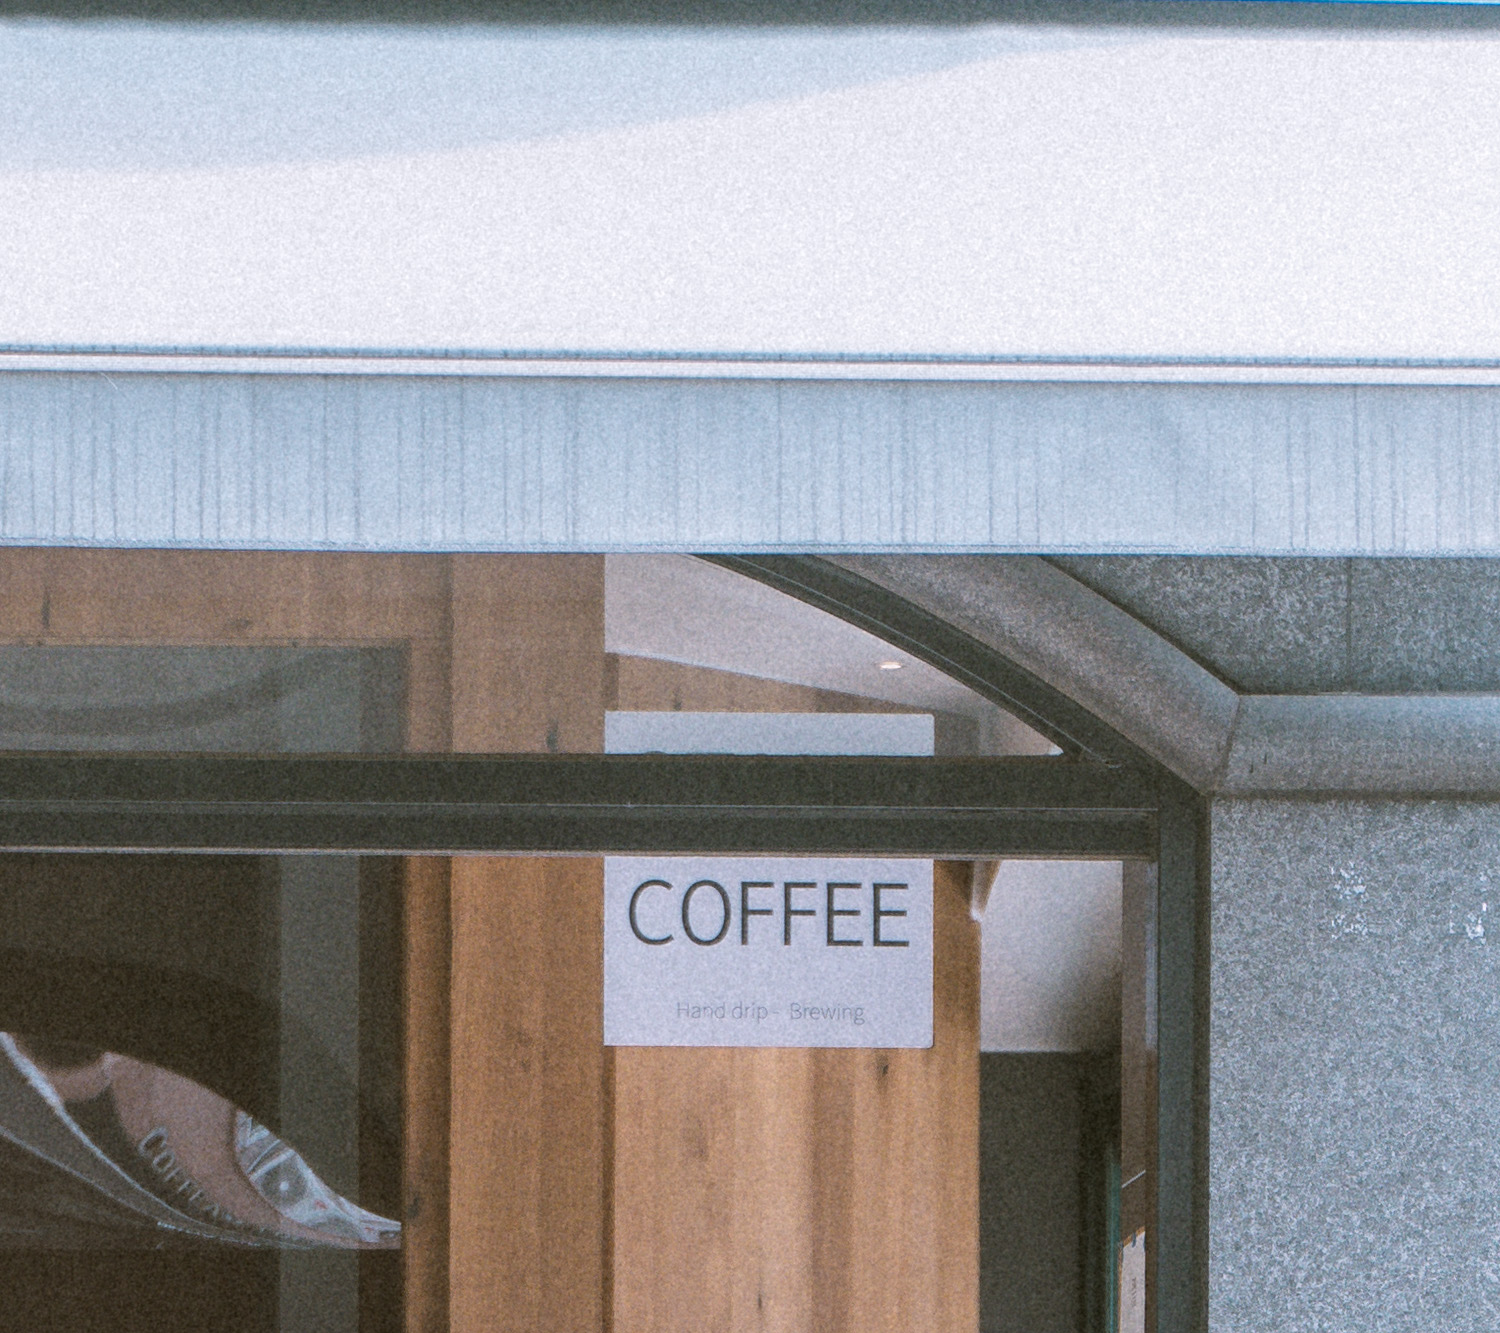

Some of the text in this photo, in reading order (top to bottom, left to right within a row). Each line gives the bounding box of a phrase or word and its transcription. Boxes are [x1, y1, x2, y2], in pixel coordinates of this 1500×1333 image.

[628, 878, 911, 948] COFFEE
[676, 1001, 726, 1020] Hand
[732, 1001, 769, 1024] drip
[789, 1001, 866, 1026] Brewing
